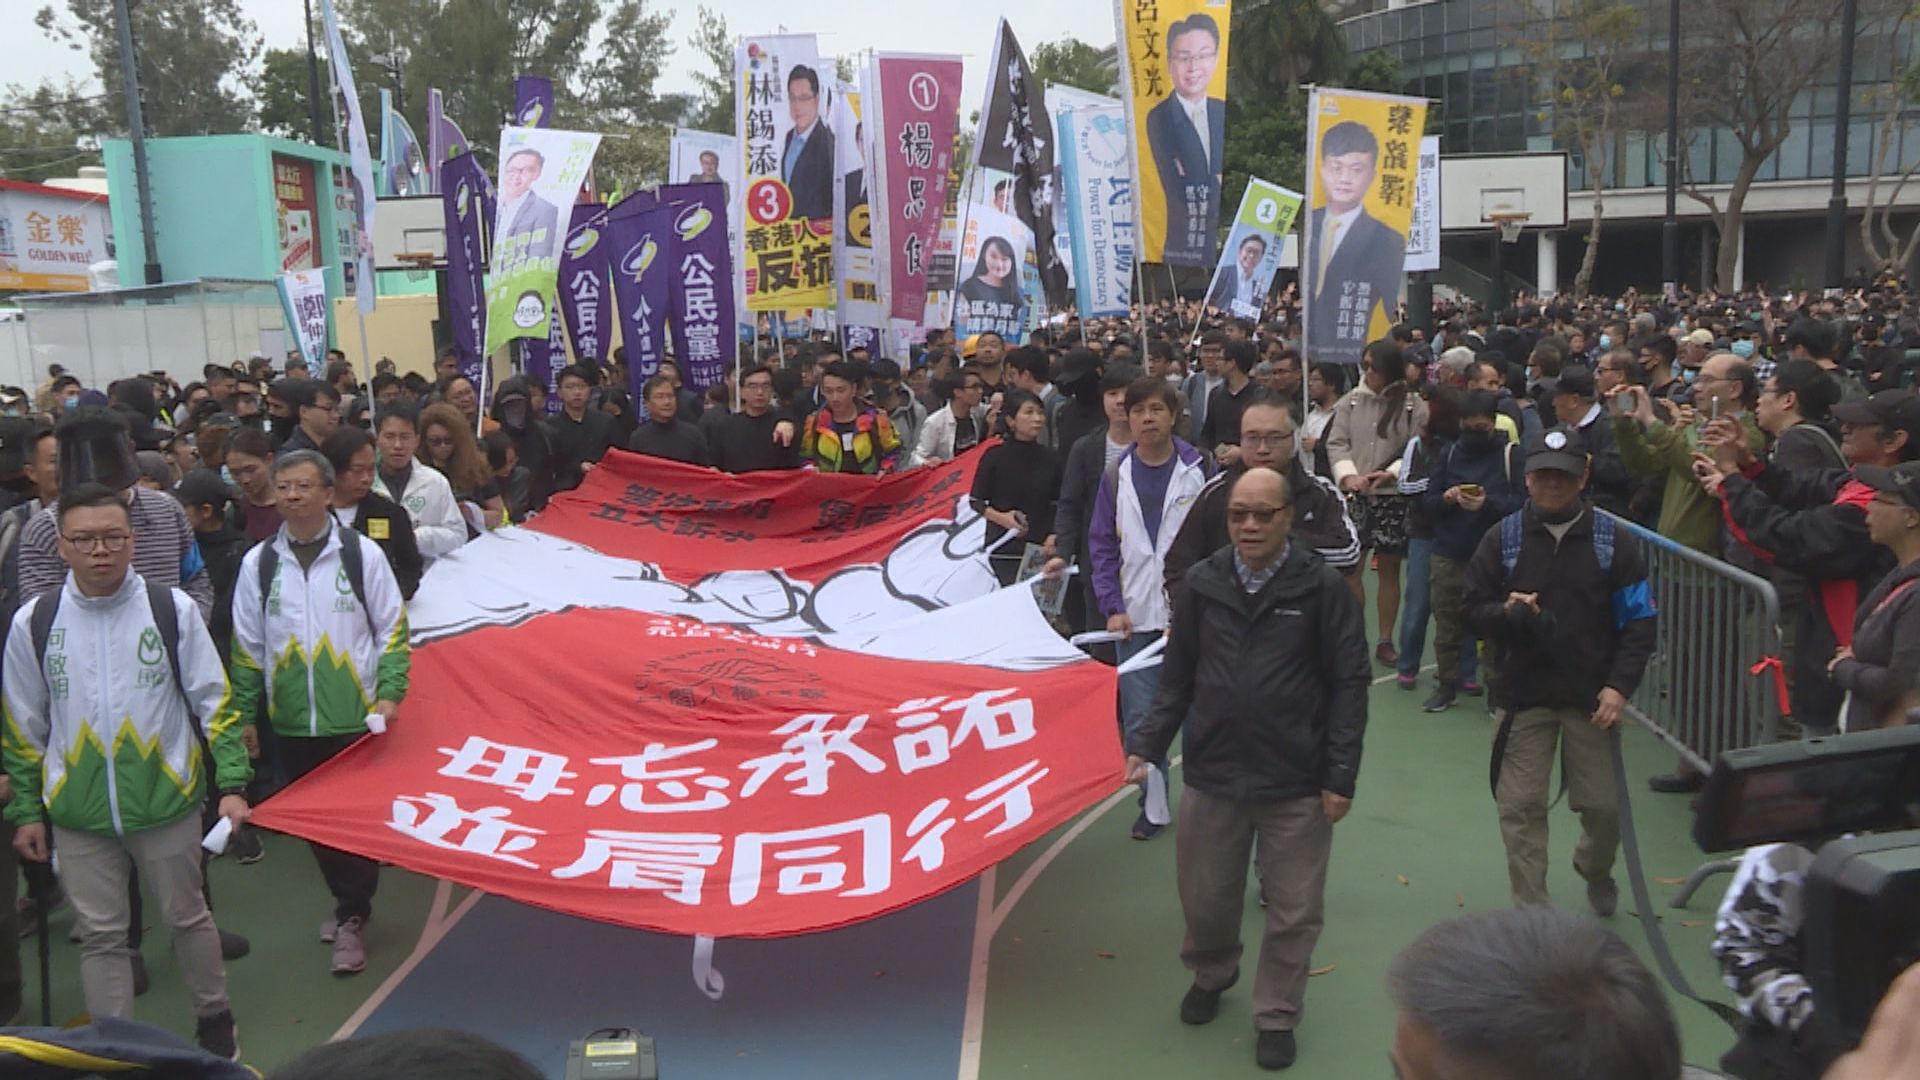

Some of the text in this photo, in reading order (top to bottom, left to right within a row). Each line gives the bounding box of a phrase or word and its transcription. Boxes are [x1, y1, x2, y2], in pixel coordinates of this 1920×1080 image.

[26, 210, 85, 246] 金樂
[758, 184, 780, 220] 3
[28, 248, 90, 264] GOLDEN WELL
[745, 220, 818, 252] 香港人
[1088, 178, 1108, 306] Power for Democracy
[757, 242, 833, 294] 反抗
[680, 253, 721, 361] 公民黨
[437, 687, 1037, 813] 毋忘承諾
[385, 758, 1050, 906] 並肩同行
